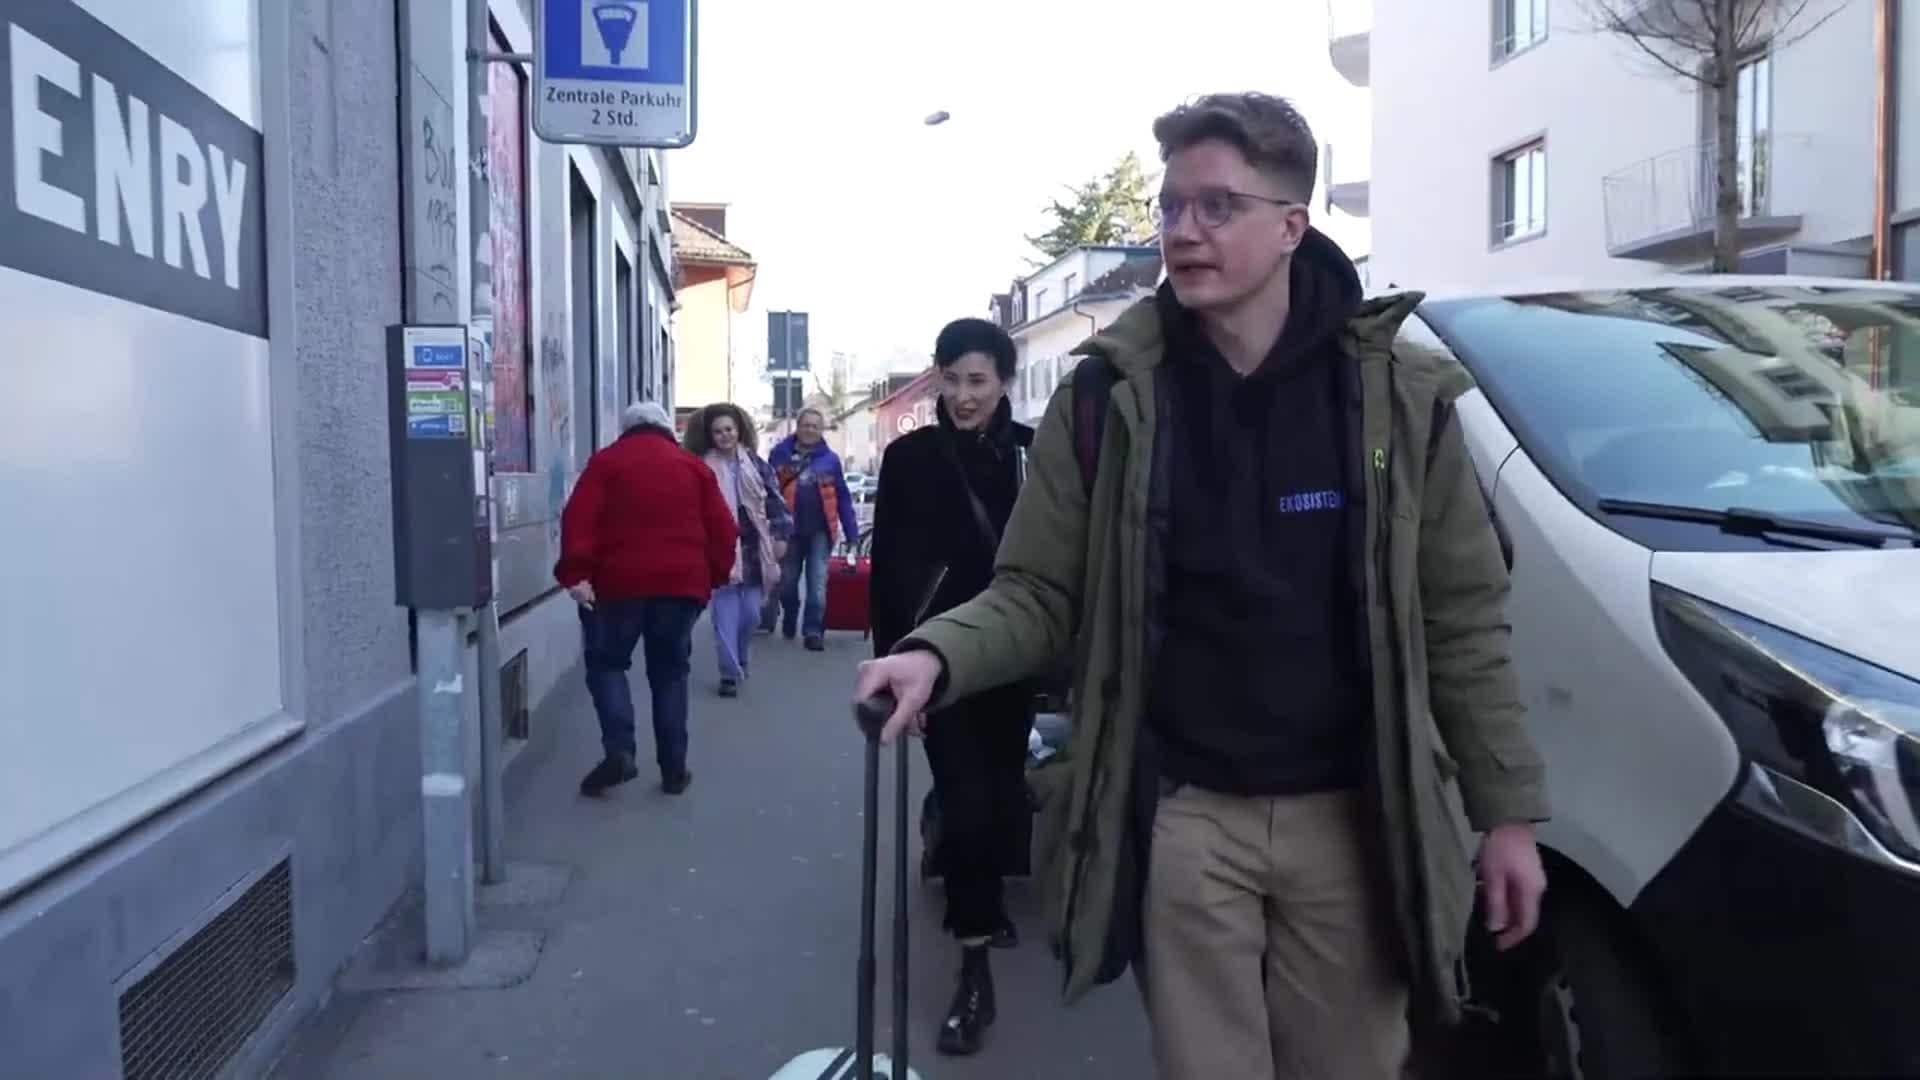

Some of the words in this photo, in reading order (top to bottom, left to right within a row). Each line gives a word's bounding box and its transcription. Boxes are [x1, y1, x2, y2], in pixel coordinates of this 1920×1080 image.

[546, 86, 616, 105] Zentrale
[622, 89, 681, 108] Parkuhr
[591, 109, 601, 125] 2
[607, 110, 638, 126] Std.
[9, 20, 247, 290] ENRY
